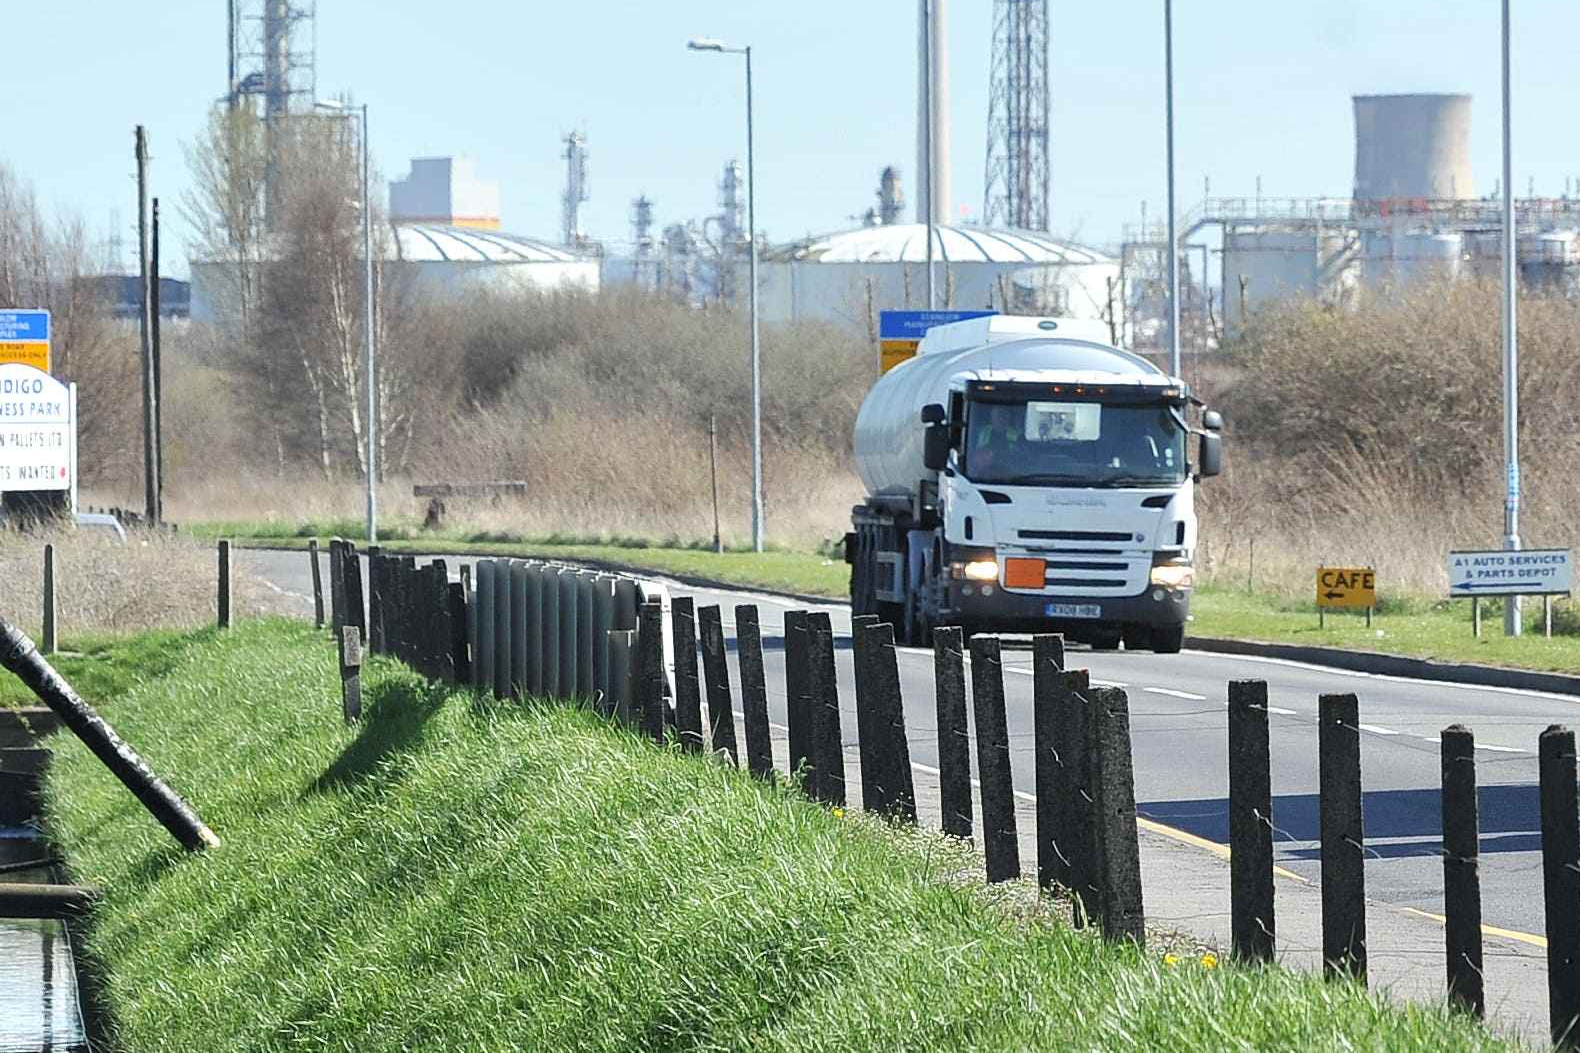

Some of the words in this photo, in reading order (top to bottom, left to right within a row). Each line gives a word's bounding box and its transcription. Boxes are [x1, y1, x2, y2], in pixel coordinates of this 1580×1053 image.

[0, 378, 43, 394] DIGO
[30, 402, 61, 416] PARK
[10, 432, 44, 447] PALLETS
[19, 465, 55, 480] WANTED
[1455, 559, 1469, 567] A1
[1474, 557, 1504, 566] AUTO
[1509, 555, 1566, 565] SERVICES
[1466, 570, 1473, 579] &
[1478, 569, 1514, 578] PARTS
[1518, 567, 1557, 577] DEPOT
[1321, 572, 1375, 590] CAFE
